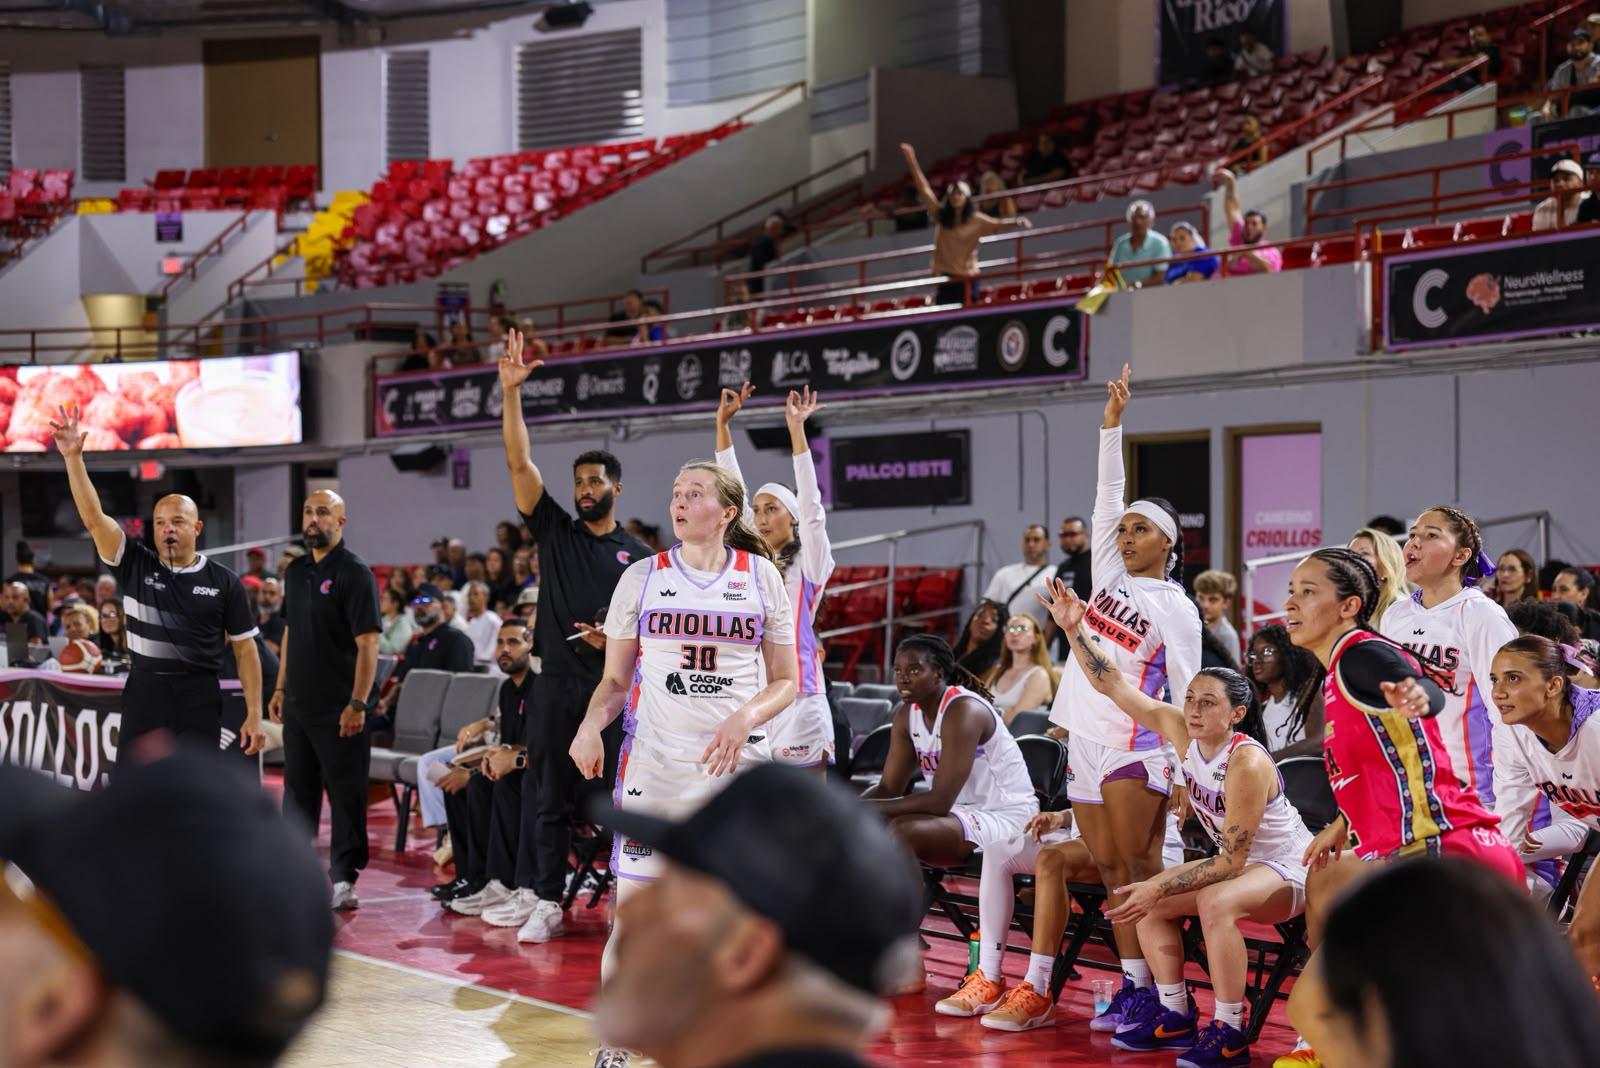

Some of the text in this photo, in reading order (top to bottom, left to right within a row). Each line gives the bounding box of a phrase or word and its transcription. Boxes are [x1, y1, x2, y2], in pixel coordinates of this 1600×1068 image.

[845, 459, 953, 481] PALCO ESTE
[1245, 528, 1322, 548] CRIOLLOS
[647, 612, 758, 642] CRIOLLAS
[681, 644, 718, 672] 30
[689, 674, 734, 687] CAGUAS
[690, 684, 723, 694] COOP
[623, 845, 652, 855] CRIOLLAS
